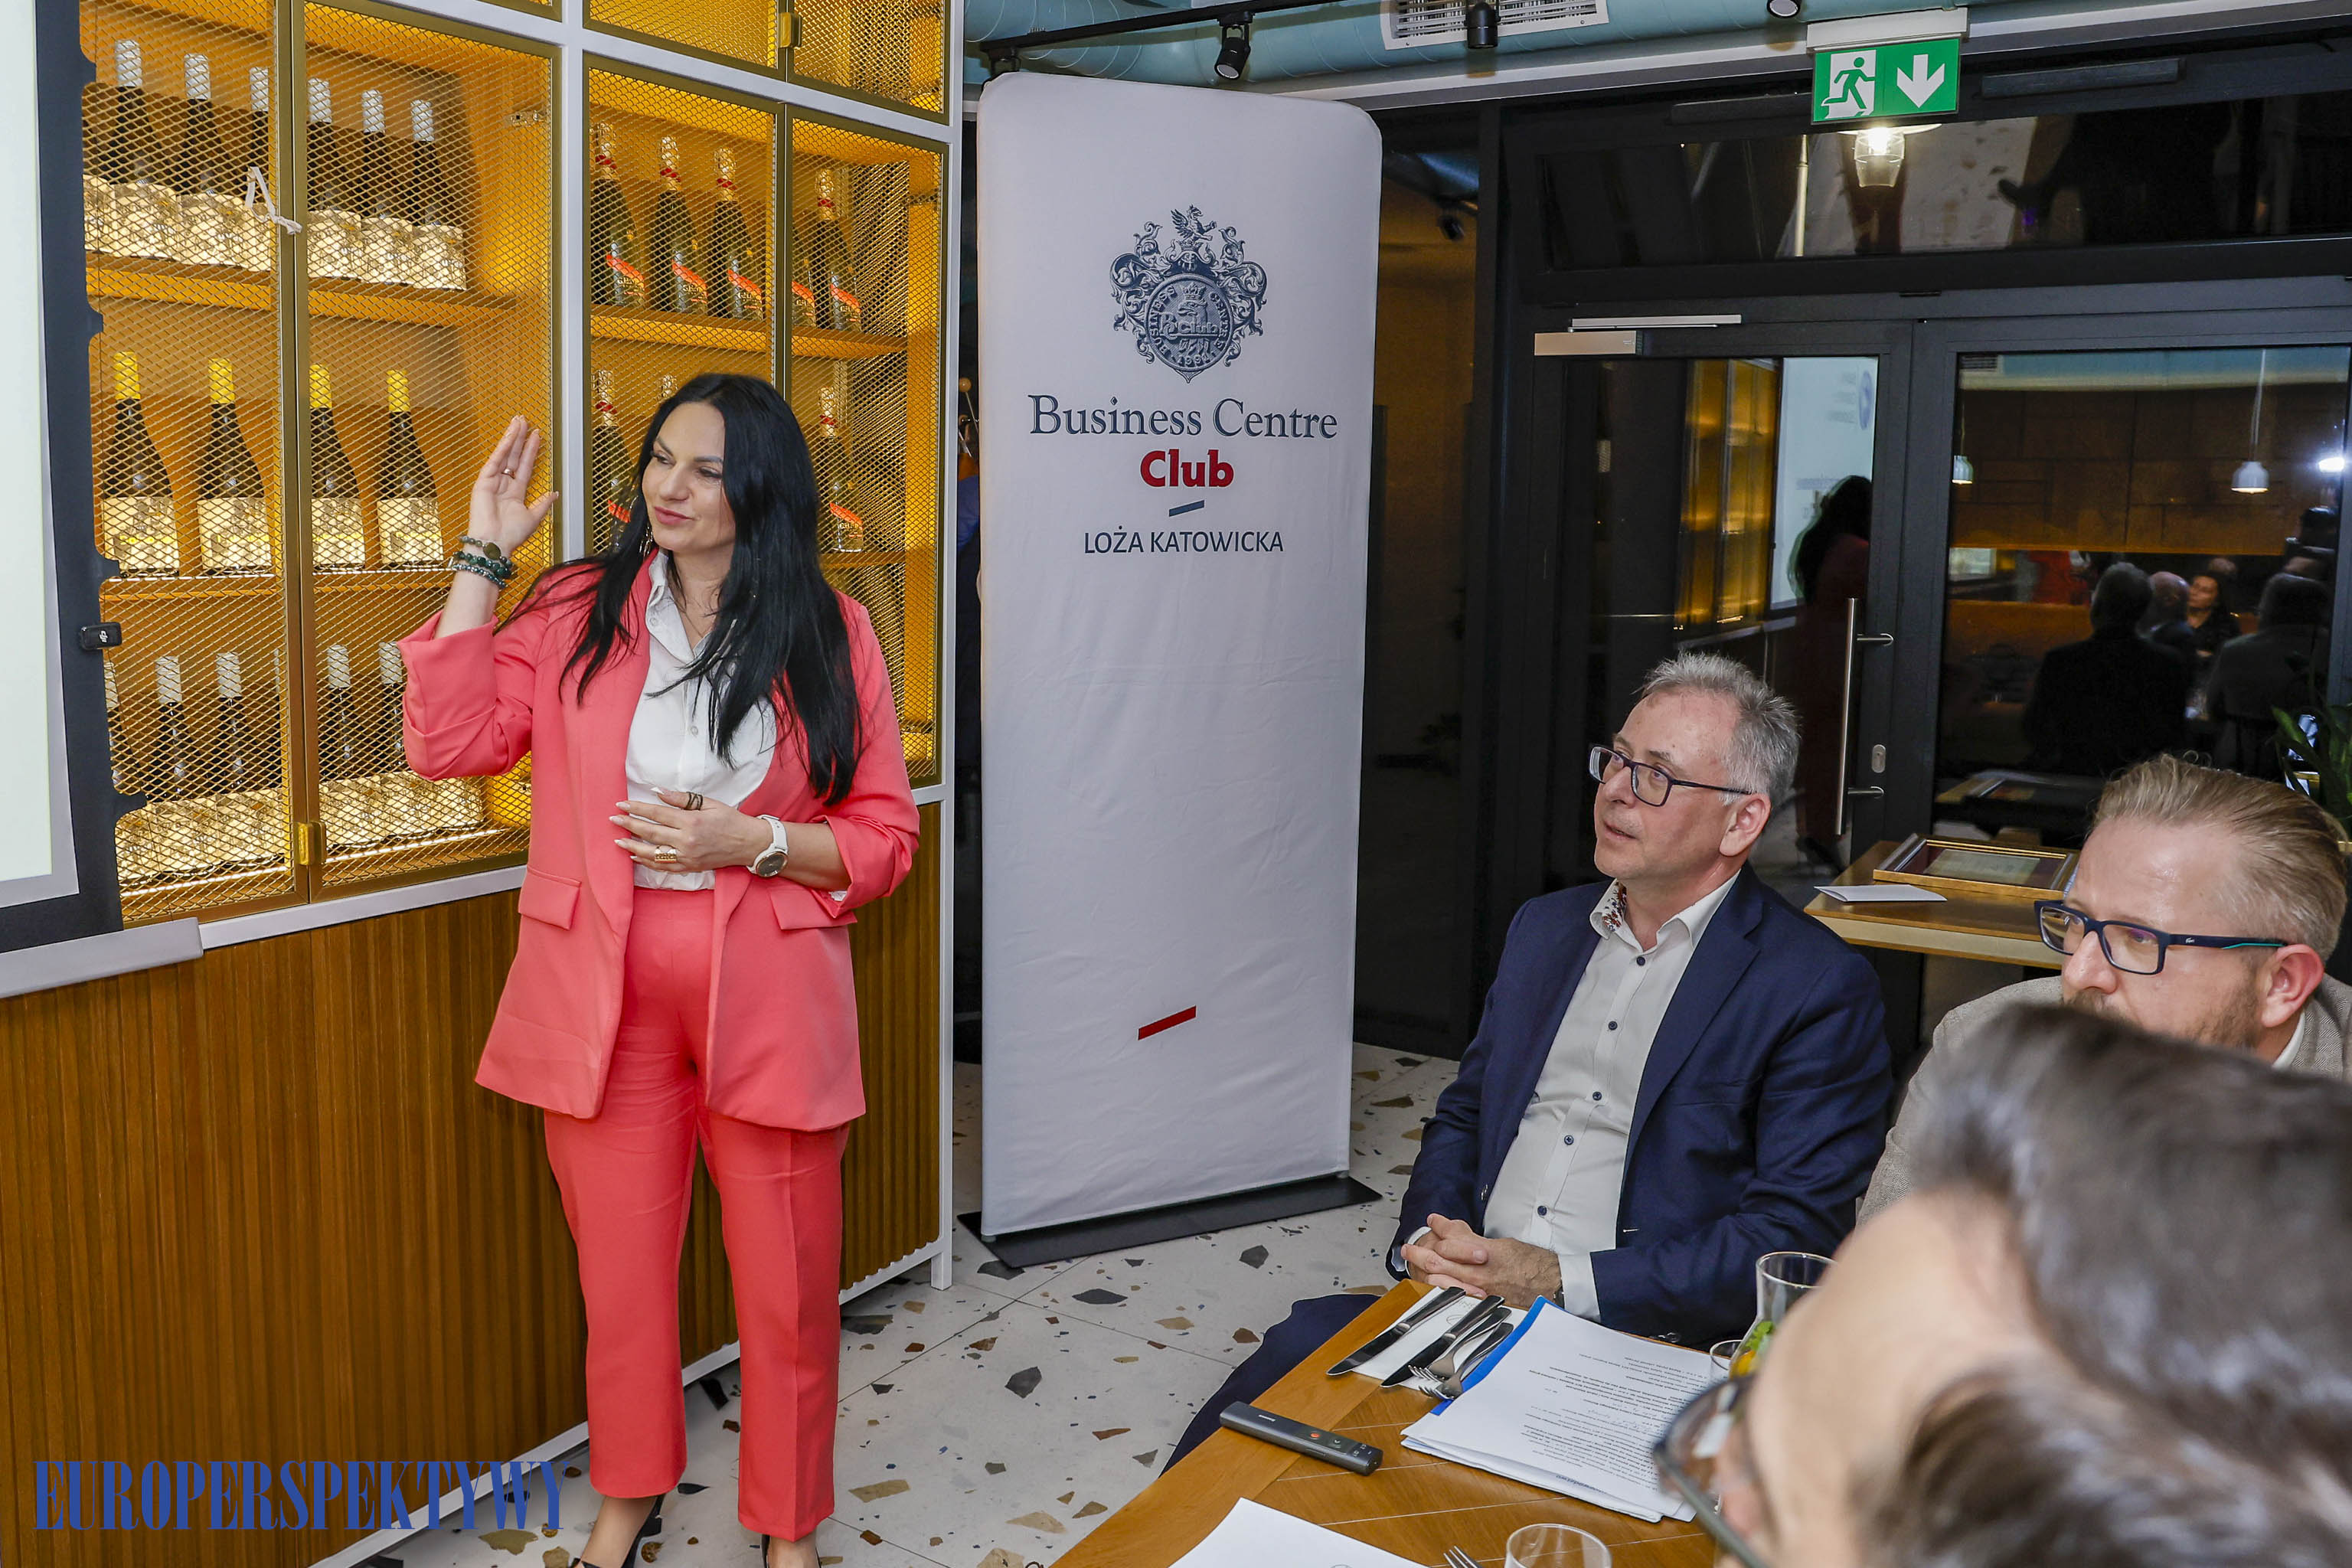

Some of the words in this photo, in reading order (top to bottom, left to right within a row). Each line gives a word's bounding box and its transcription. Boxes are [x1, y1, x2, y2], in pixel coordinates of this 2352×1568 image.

[1149, 286, 1177, 355] BUSINESS
[1028, 395, 1200, 436] Business
[1213, 397, 1338, 439] Centre
[1140, 449, 1234, 487] Club
[1085, 526, 1144, 554] LOŻA
[1151, 531, 1283, 552] KATOWICKA
